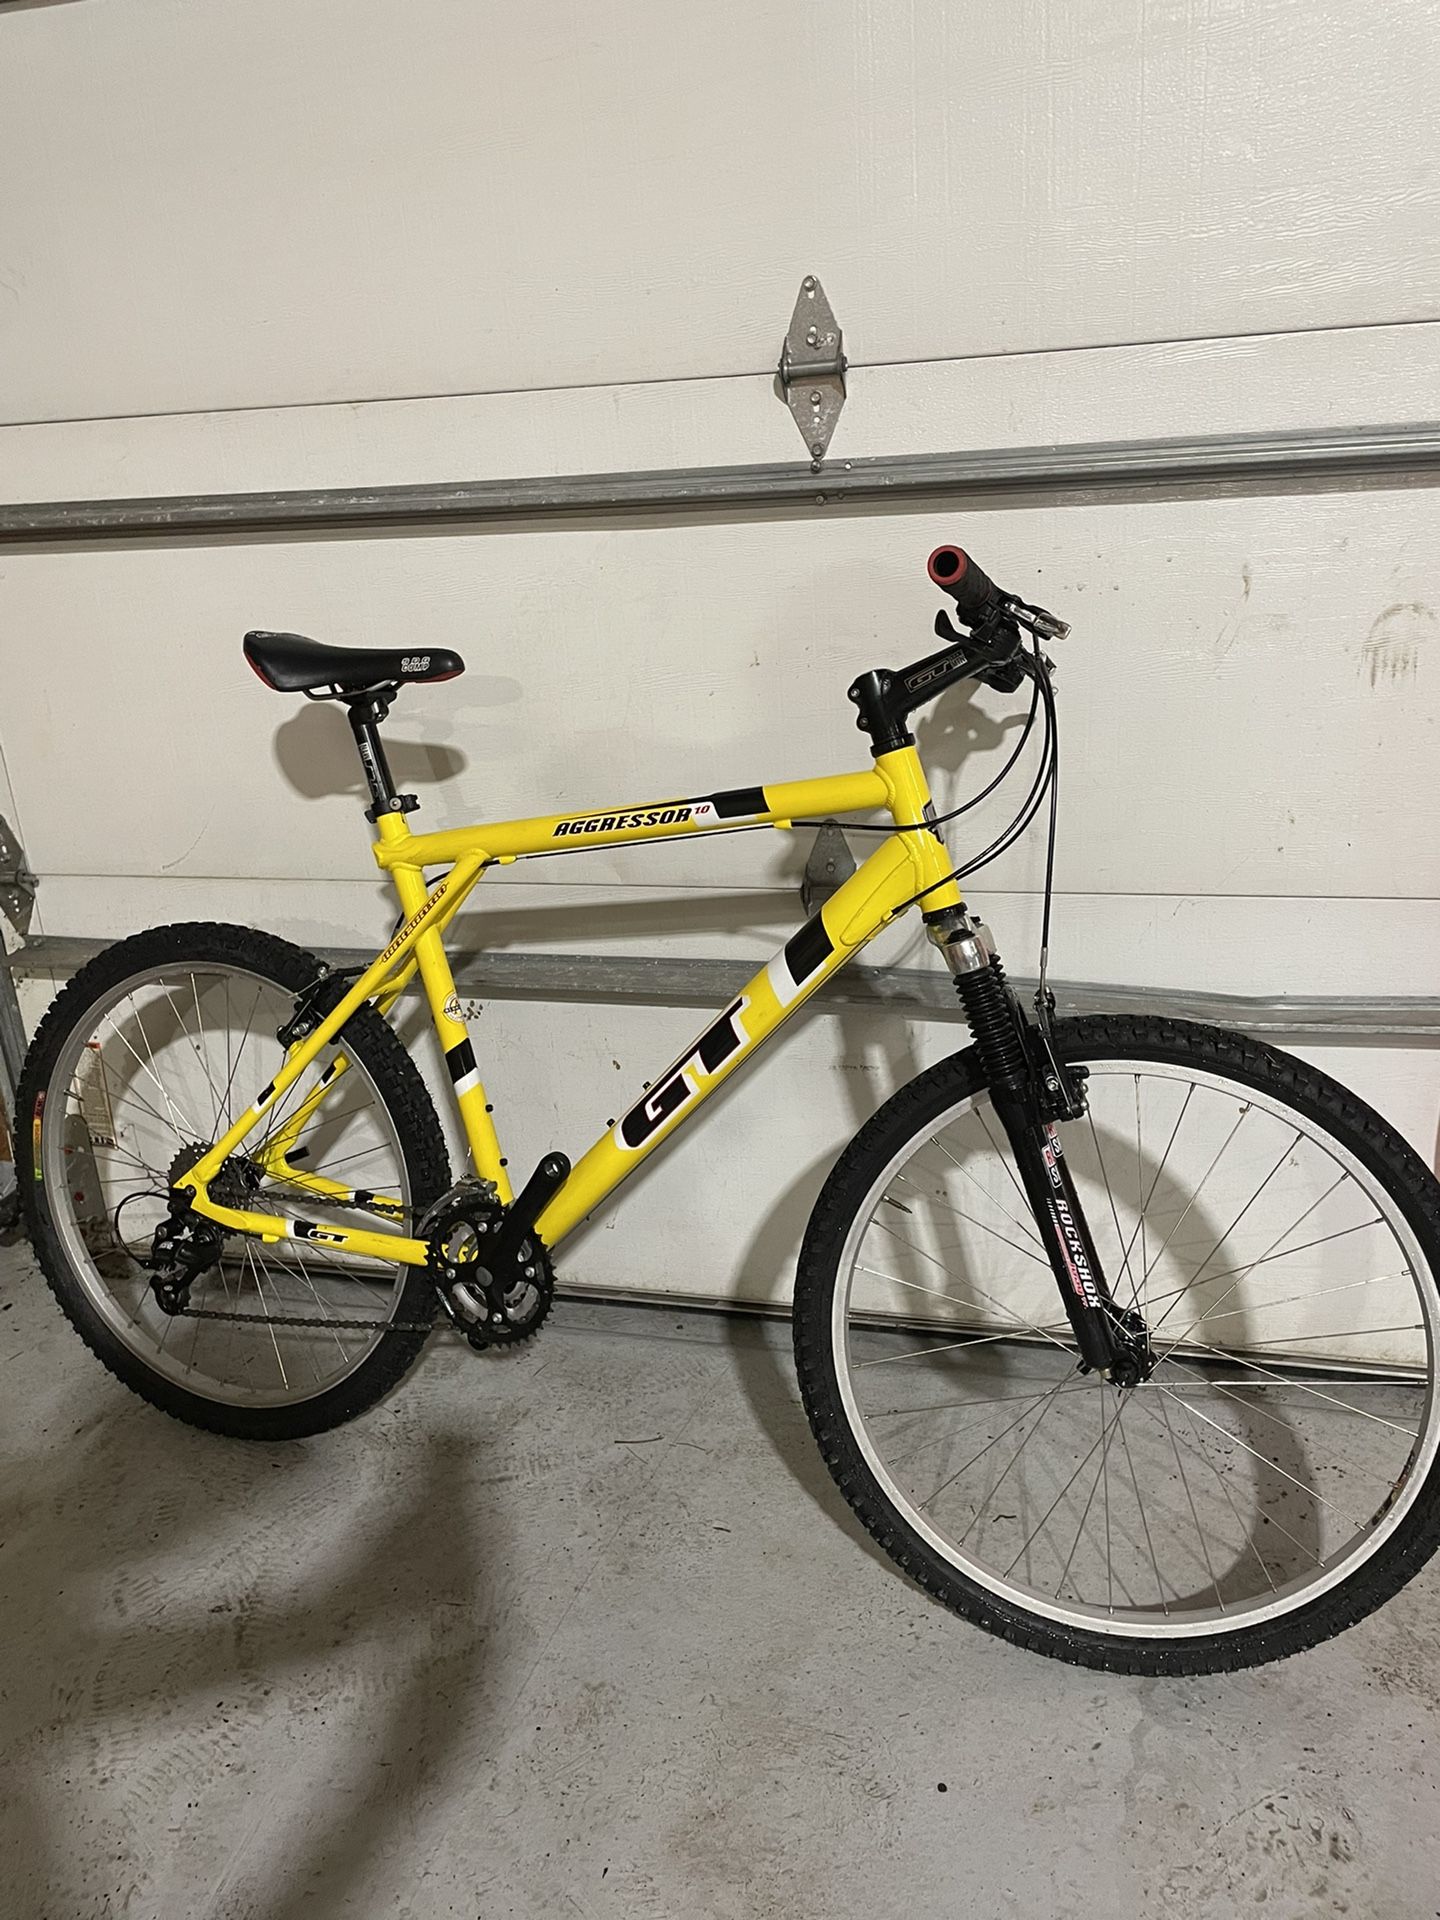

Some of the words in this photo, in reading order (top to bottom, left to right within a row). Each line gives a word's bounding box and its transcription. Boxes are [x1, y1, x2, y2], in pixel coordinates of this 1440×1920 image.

[552, 807, 693, 837] AGGRESSOR
[694, 805, 710, 815] 10
[621, 996, 743, 1148] GT
[309, 1230, 349, 1243] GT
[1055, 1198, 1102, 1309] ROCKSHOX
